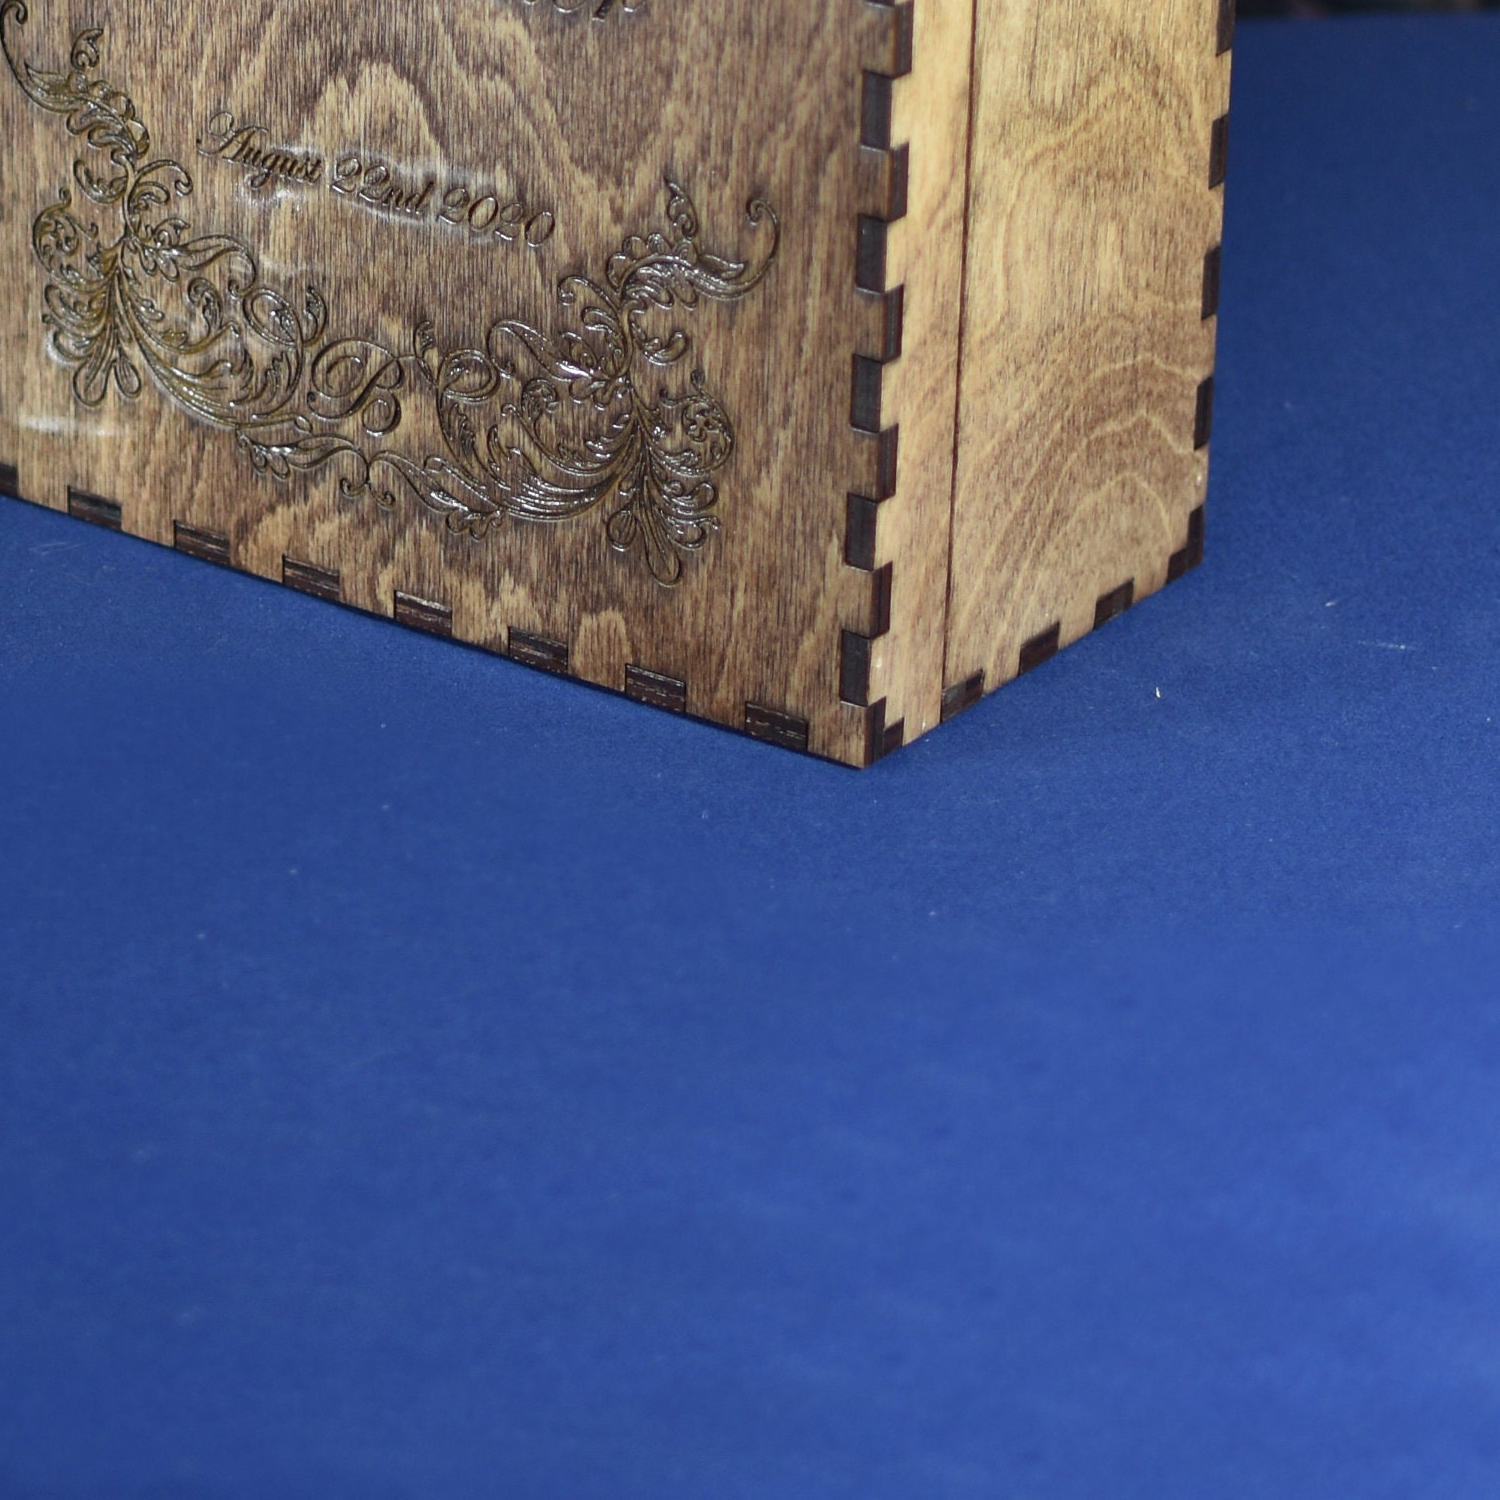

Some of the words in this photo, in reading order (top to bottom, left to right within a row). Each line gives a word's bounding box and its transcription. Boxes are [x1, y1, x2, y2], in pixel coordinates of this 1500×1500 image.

[195, 111, 323, 190] August
[330, 157, 435, 216] 22nd
[435, 187, 556, 247] 2020
